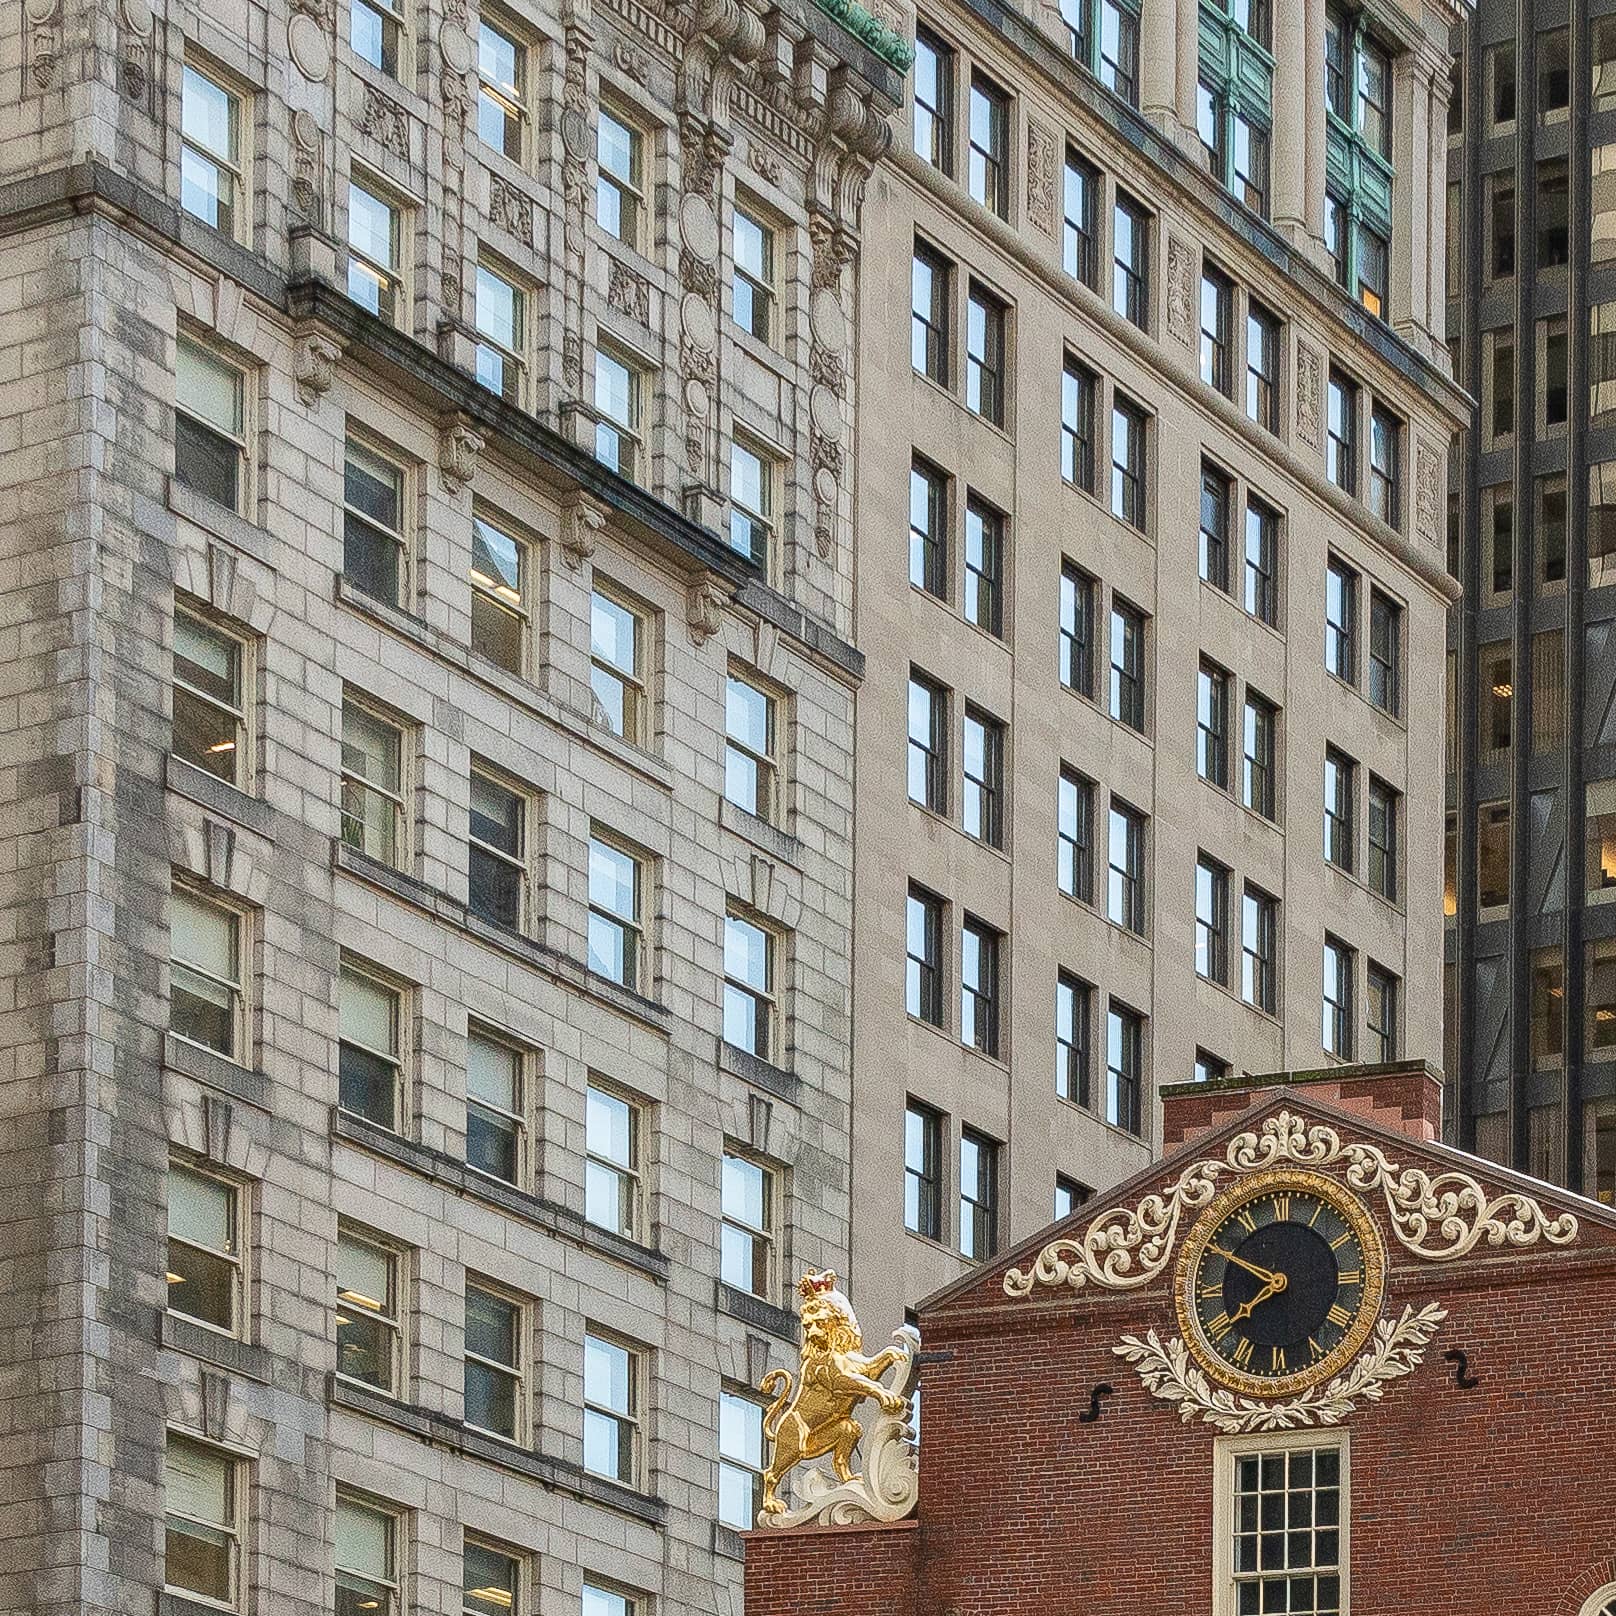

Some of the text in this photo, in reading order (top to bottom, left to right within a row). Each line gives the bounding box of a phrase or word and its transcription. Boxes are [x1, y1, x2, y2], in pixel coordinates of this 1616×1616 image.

[1273, 1197, 1289, 1222] XII
[1329, 1231, 1351, 1251] II
[1338, 1269, 1360, 1286] III
[1201, 1282, 1223, 1298] IX
[1307, 1336, 1324, 1359] V
[1272, 1346, 1287, 1371] VI
